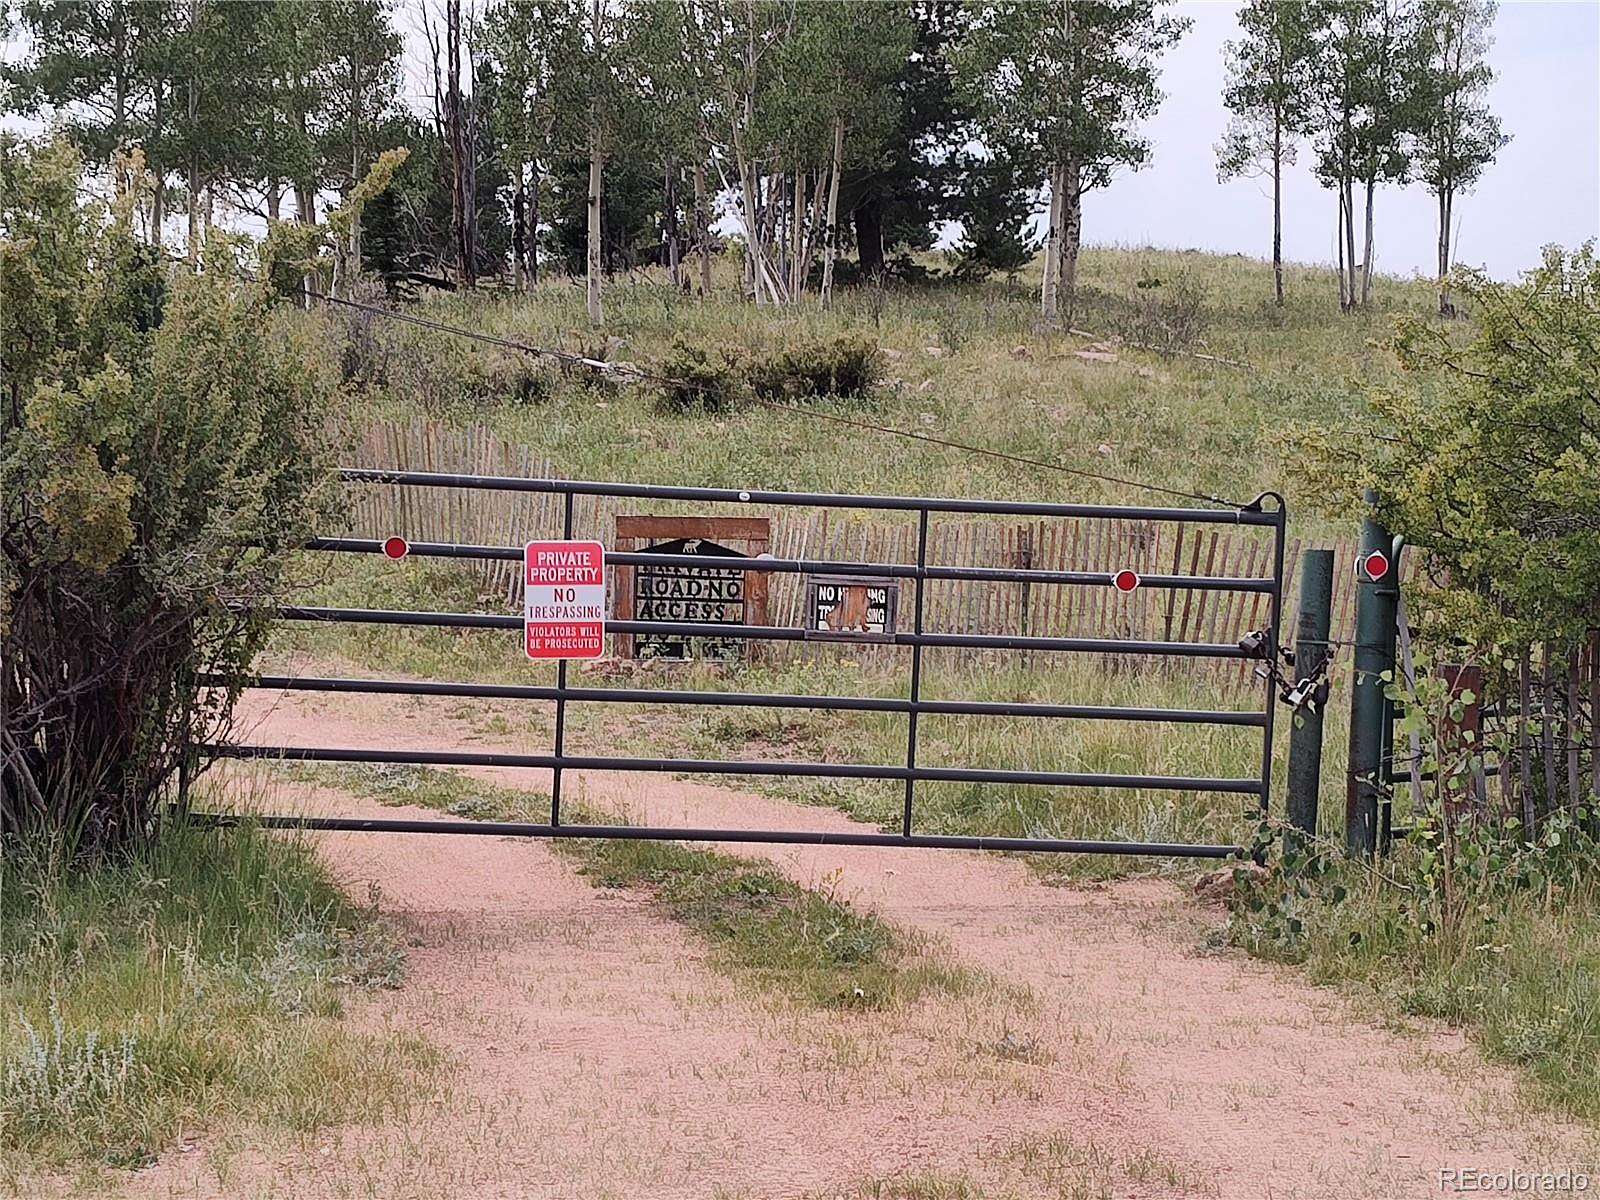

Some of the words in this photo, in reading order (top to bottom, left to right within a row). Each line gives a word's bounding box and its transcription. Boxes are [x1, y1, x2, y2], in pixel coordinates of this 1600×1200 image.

[537, 551, 592, 566] PRIVATE
[530, 567, 599, 582] PROPERTY
[554, 588, 576, 602] NO
[818, 586, 835, 601] NO
[529, 606, 601, 619] TRESPASSING
[638, 600, 726, 621] ACCESS
[529, 626, 577, 637] VIOLATORS
[580, 626, 600, 637] WILL
[530, 638, 541, 649] BE
[544, 638, 600, 649] PROSECUTED
